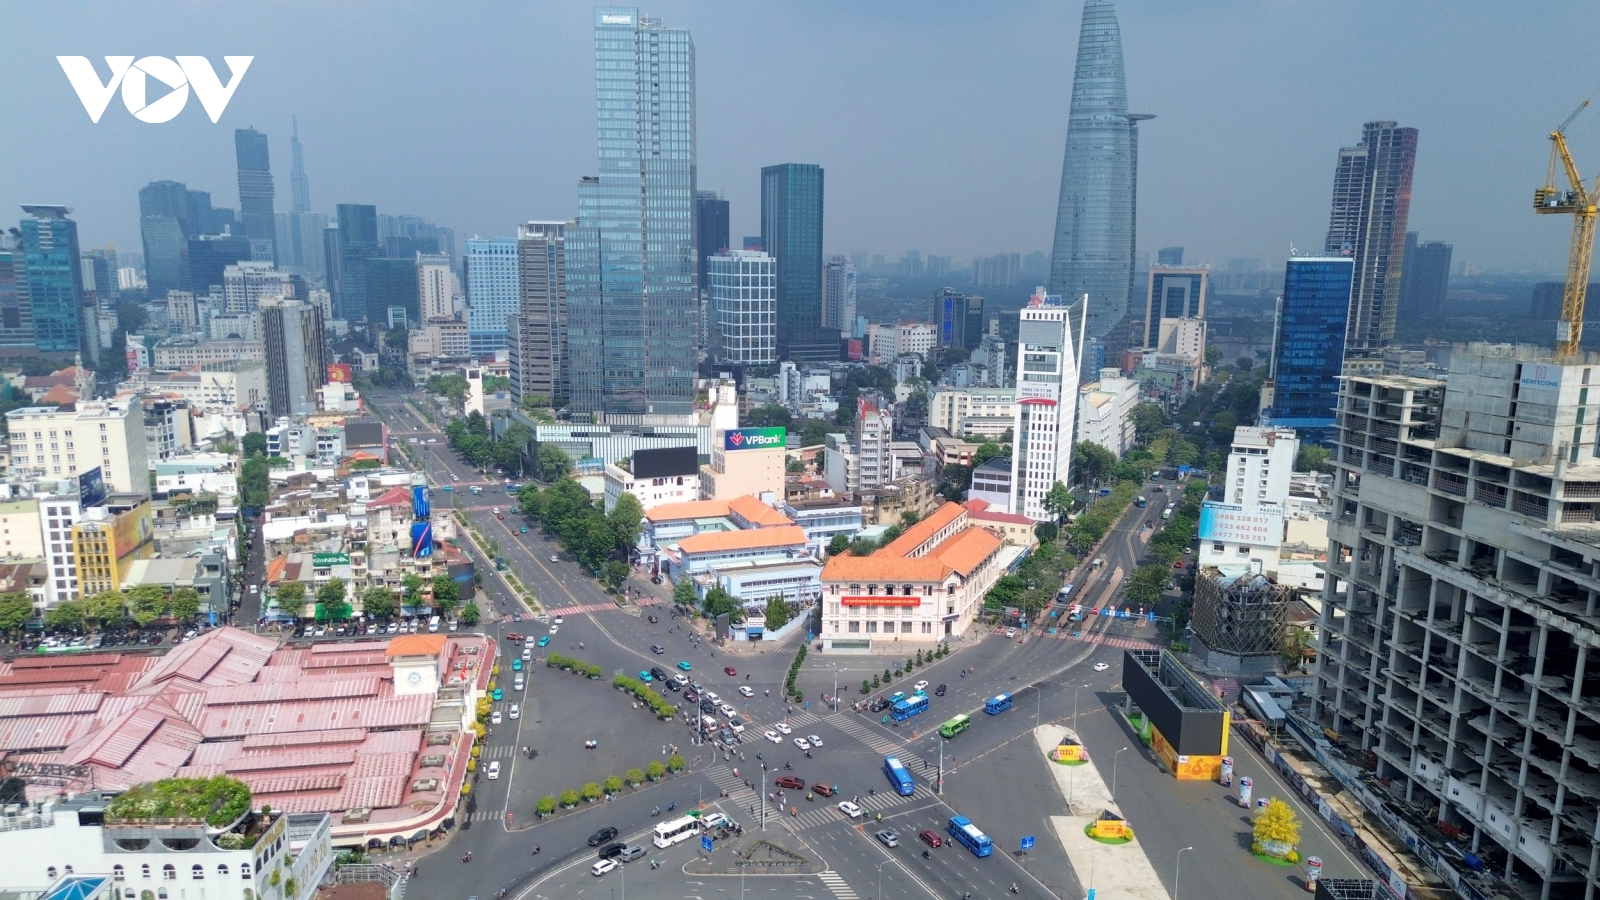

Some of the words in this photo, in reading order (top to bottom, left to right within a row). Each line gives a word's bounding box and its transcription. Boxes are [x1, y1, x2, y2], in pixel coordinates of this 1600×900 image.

[603, 15, 630, 24] Keppel
[255, 244, 268, 252] FOR
[1521, 378, 1558, 387] NEWTECONS
[745, 434, 781, 445] VPBank
[1214, 513, 1235, 521] 0908
[1253, 516, 1269, 524] 017
[1213, 522, 1234, 530] 0933
[1252, 525, 1268, 533] 404
[1251, 534, 1267, 542] 751
